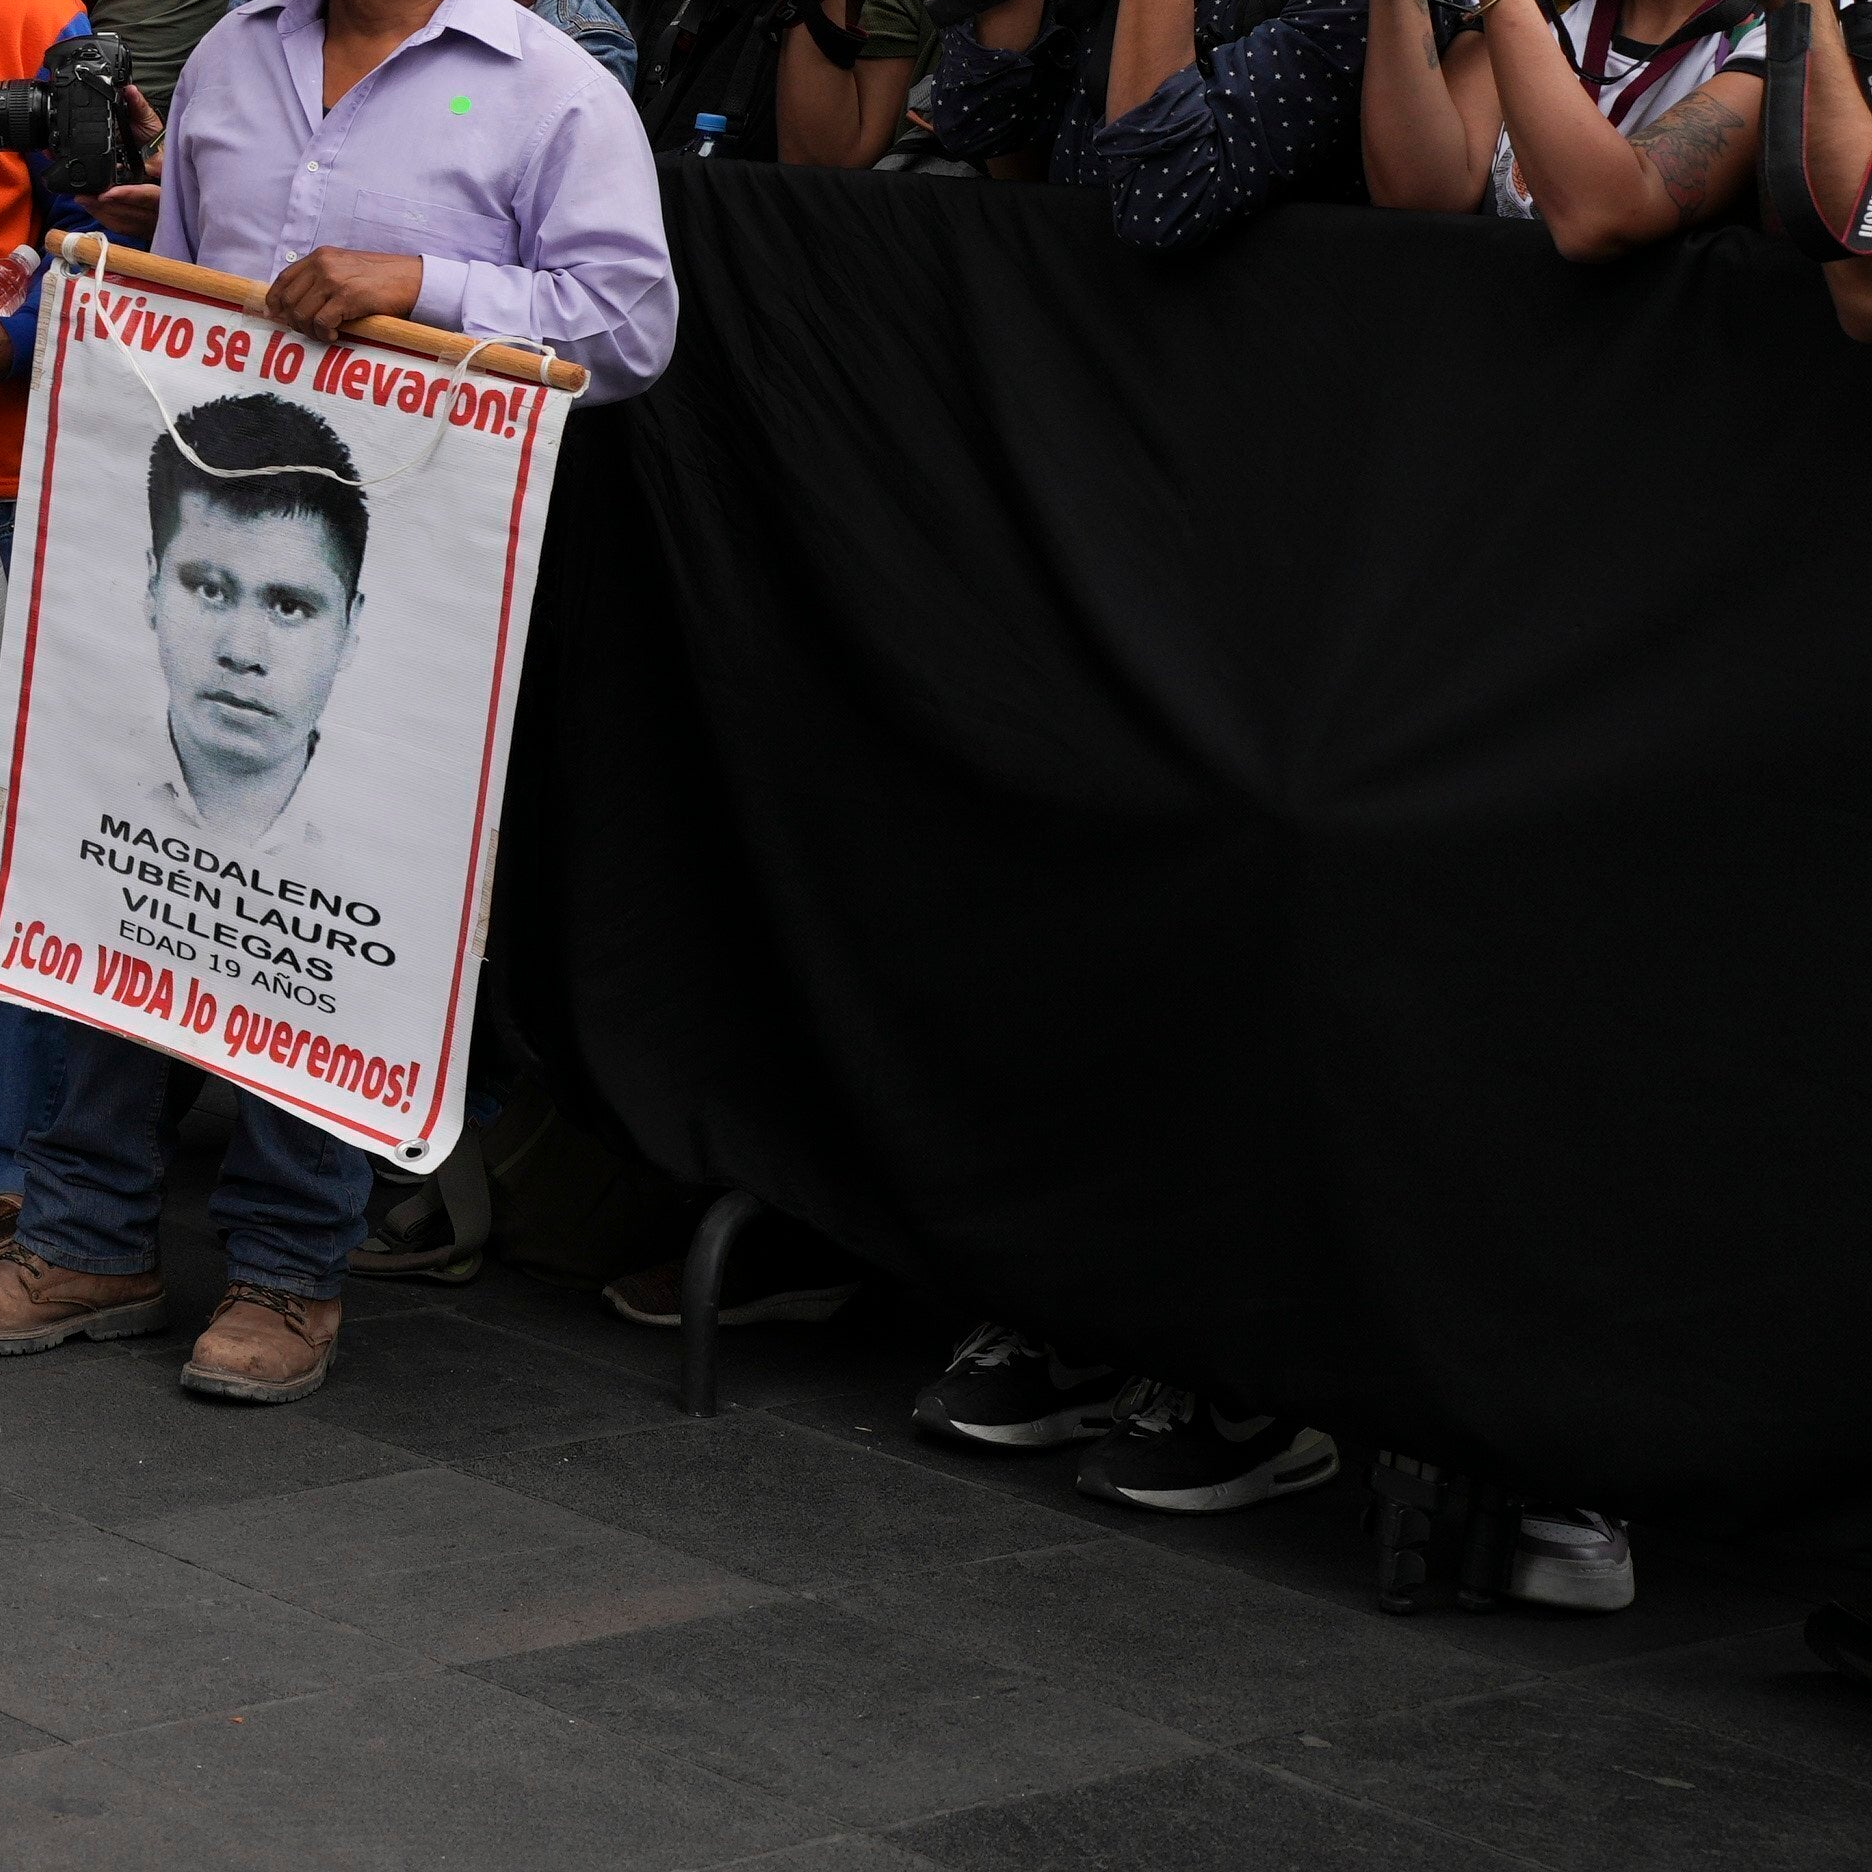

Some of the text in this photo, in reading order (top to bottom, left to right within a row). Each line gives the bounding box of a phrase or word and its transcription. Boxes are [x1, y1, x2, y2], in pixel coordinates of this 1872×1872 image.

[74, 289, 526, 440] ¡Vivo se lo llevaron!
[80, 839, 397, 967] RUBÉN LAURO
[100, 813, 382, 927] MAGDALENO
[119, 920, 337, 1015] EDAD 19 AÑOS
[121, 887, 334, 982] VILLEGAS
[1, 921, 421, 1114] ¡Con VIDA lo queremos!
